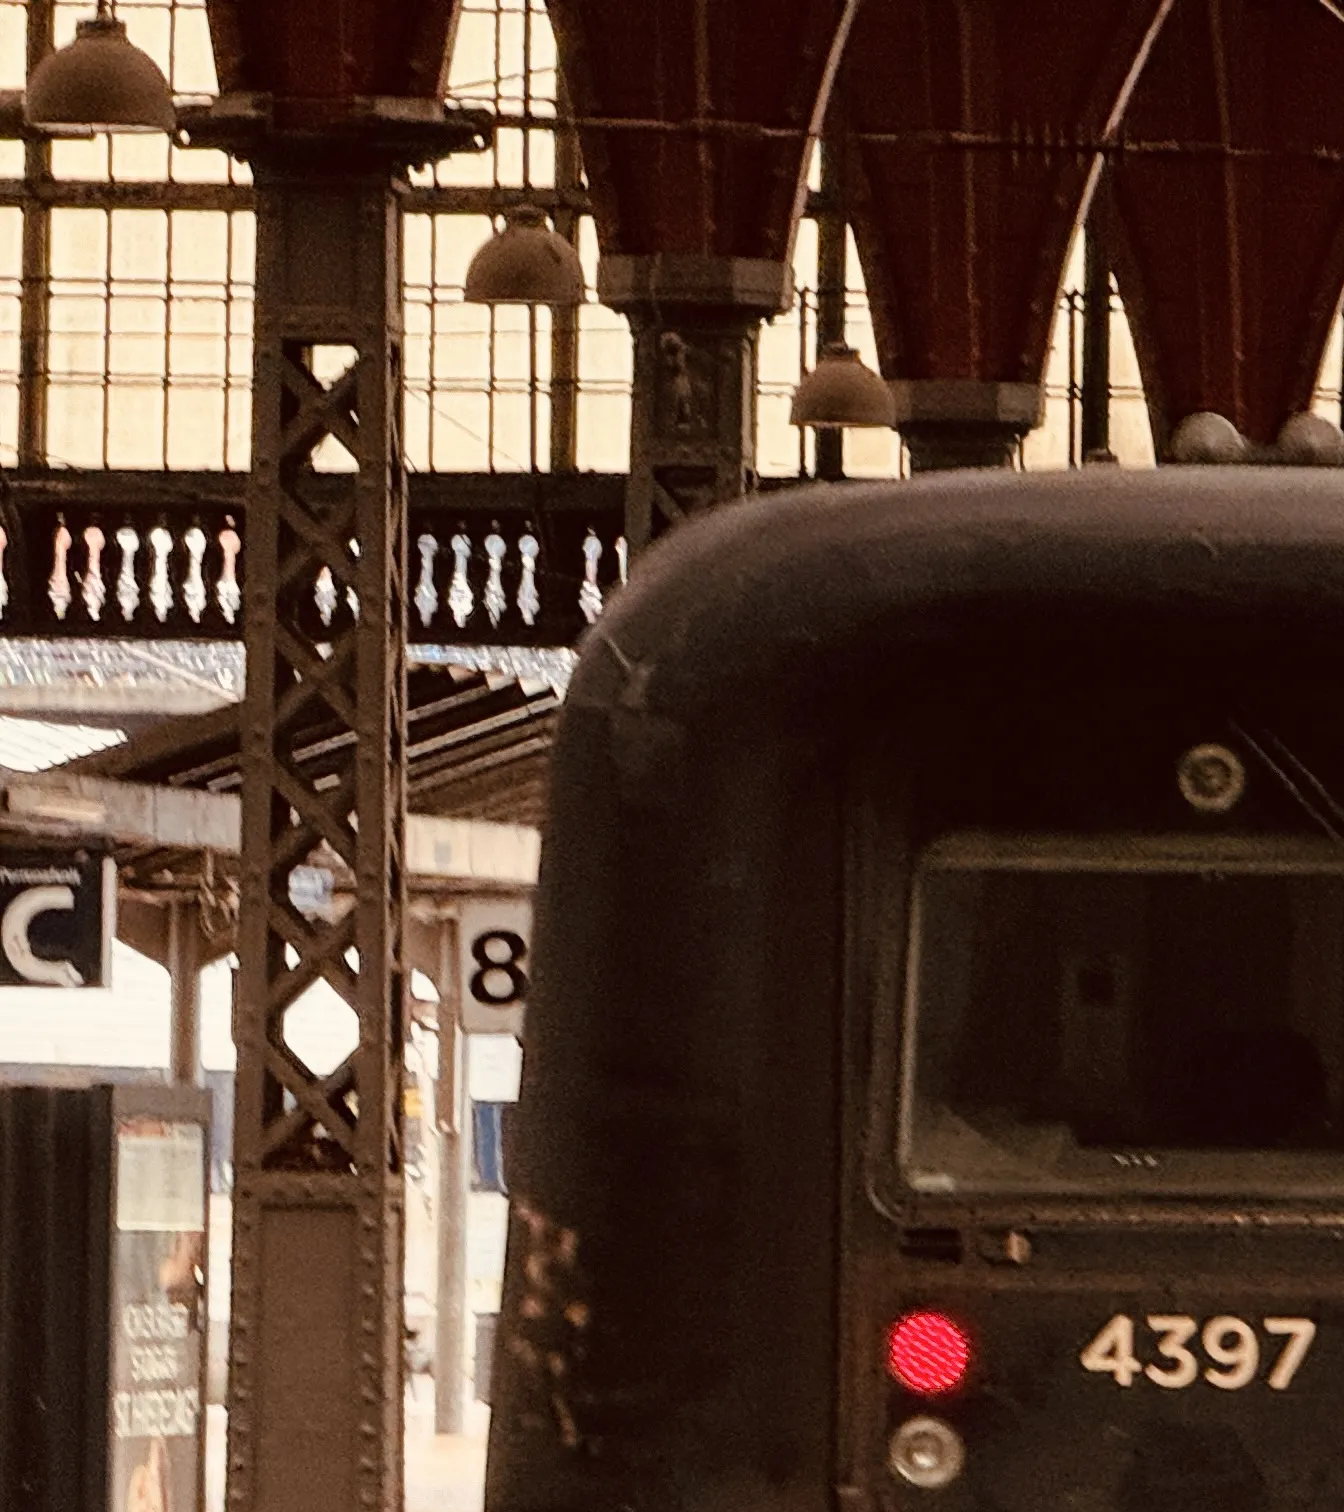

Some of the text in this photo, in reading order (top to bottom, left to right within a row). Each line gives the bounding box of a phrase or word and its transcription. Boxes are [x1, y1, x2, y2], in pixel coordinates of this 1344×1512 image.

[1, 885, 83, 987] C
[470, 930, 530, 1005] 8
[1081, 1312, 1317, 1391] 4397
